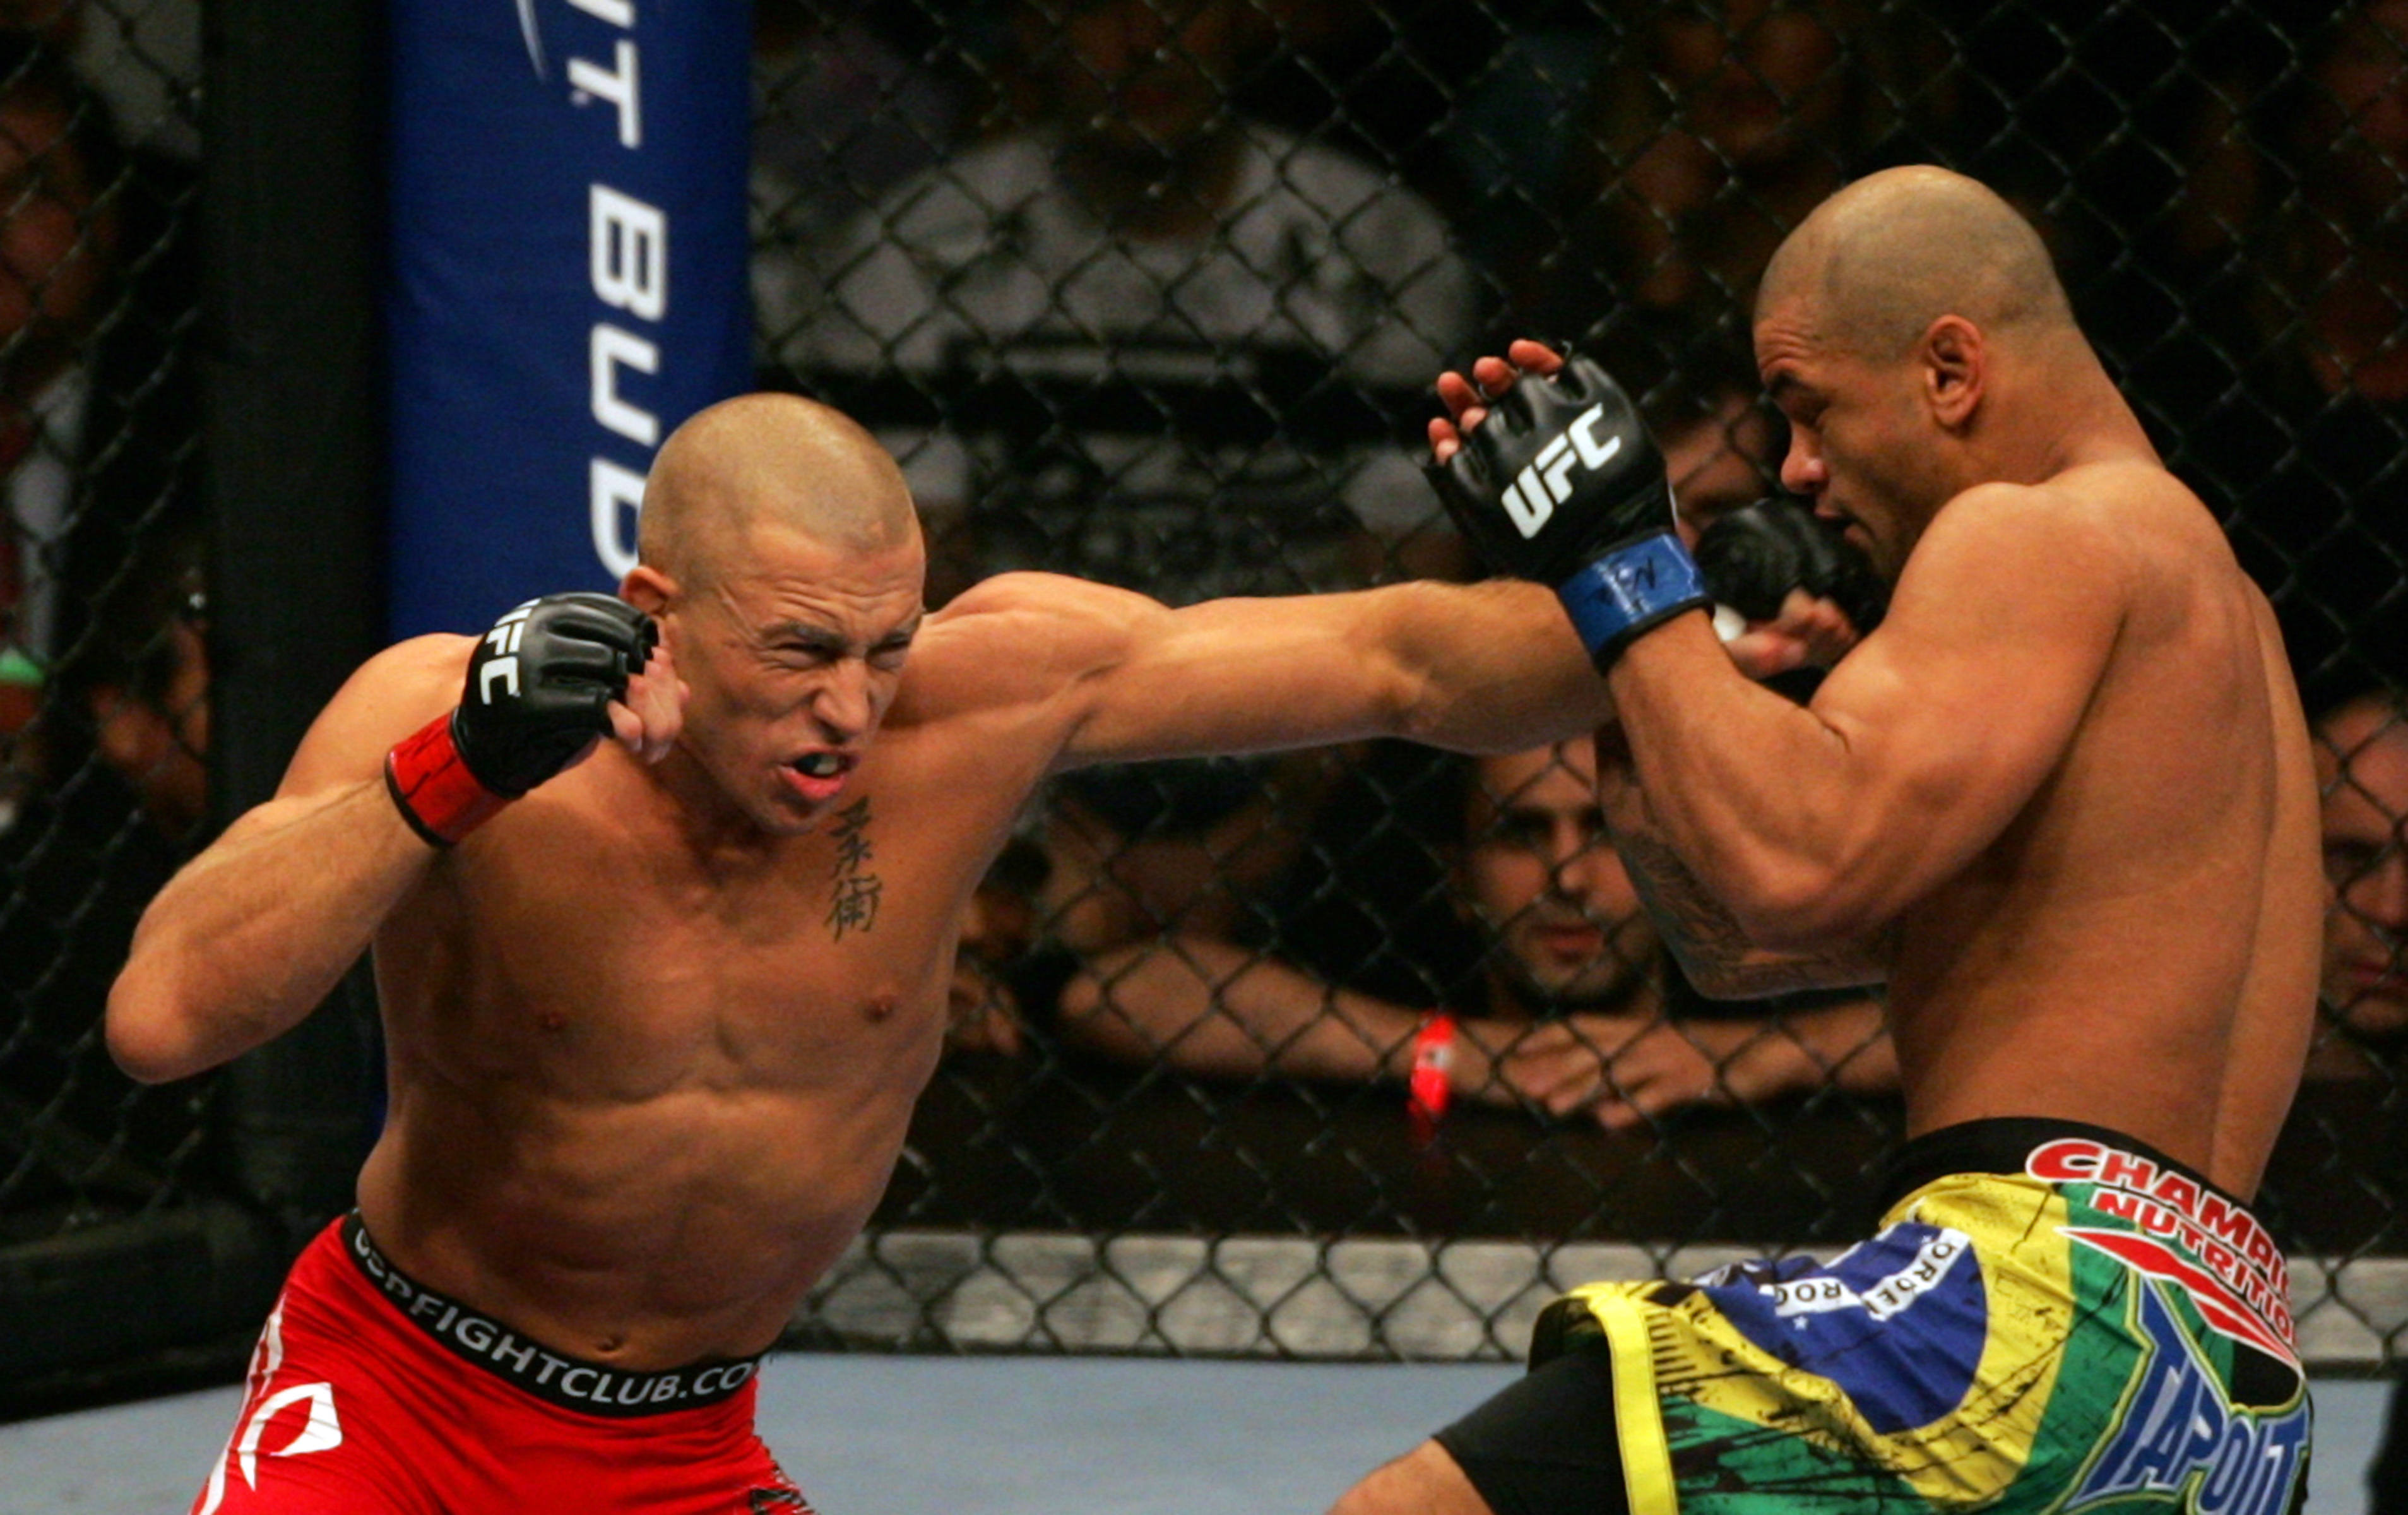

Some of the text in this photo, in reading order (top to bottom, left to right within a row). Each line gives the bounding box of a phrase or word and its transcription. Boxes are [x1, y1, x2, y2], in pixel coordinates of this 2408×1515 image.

[1501, 401, 1622, 540] UFC
[2025, 1138, 2290, 1302] CHAMPI
[2089, 1188, 2299, 1348] NUTRITIO
